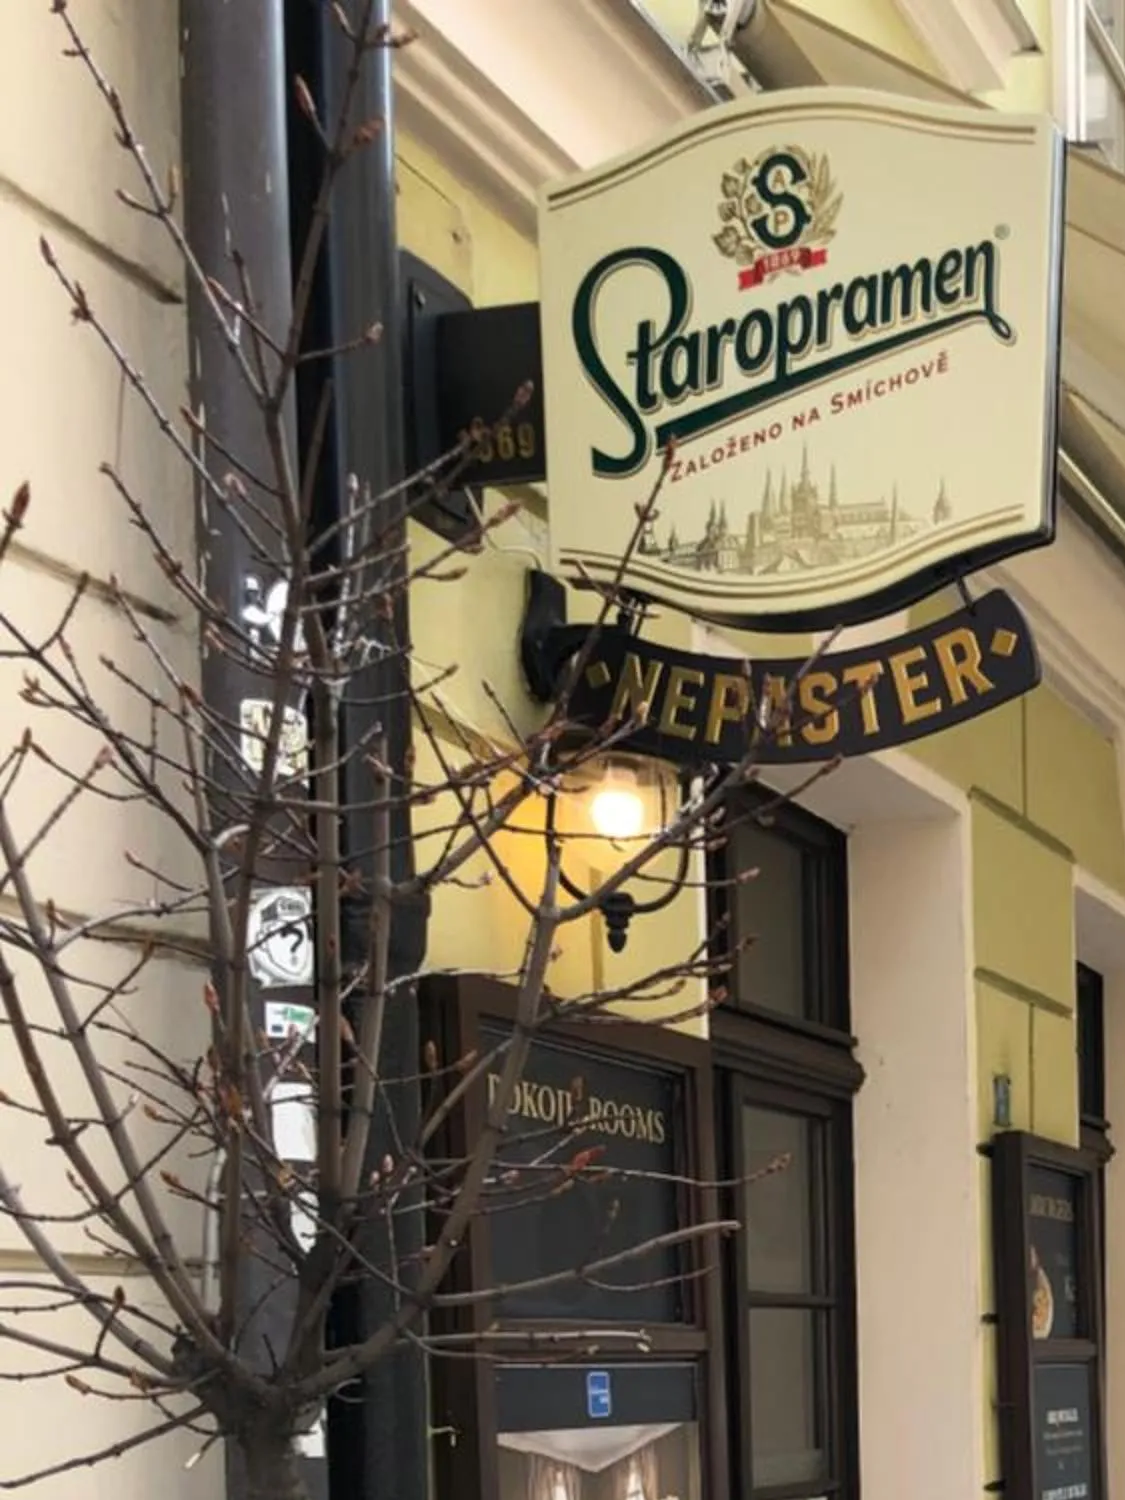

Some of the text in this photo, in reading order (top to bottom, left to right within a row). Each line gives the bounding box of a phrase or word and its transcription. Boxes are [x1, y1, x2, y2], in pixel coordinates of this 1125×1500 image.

[572, 240, 1014, 478] Staropramen
[670, 423, 783, 482] ZALOŽENO
[791, 407, 821, 431] NA
[589, 1097, 665, 1144] ROOMS
